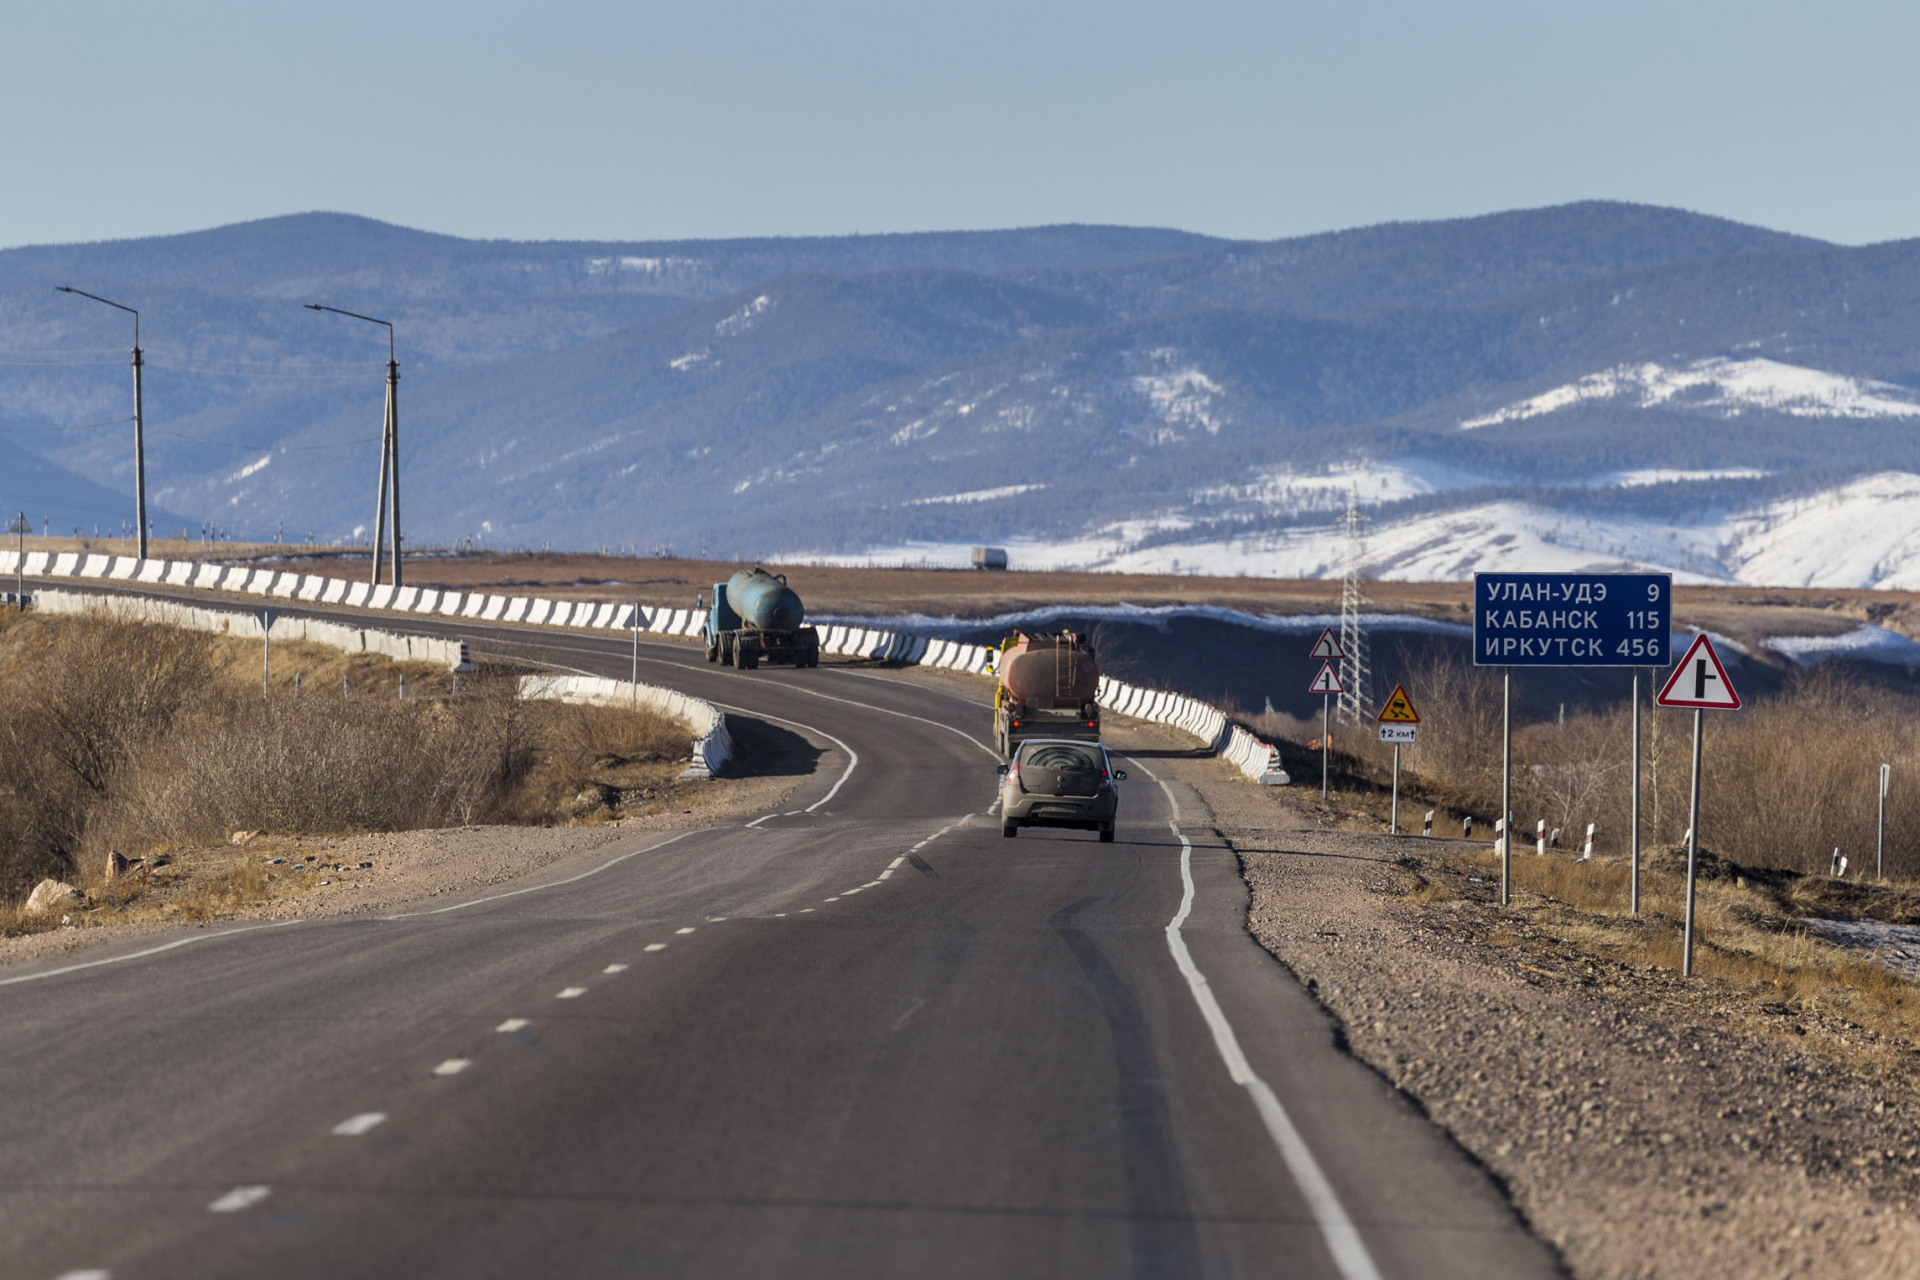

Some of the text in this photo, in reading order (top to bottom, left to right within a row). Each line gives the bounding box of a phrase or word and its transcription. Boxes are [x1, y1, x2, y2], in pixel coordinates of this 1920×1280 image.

[1487, 582, 1660, 604] УЛАН-УДЭ 9
[1486, 610, 1660, 629] КАБАНСК 115
[1485, 637, 1659, 657] ИРКУТСК 456
[1387, 729, 1394, 737] 2
